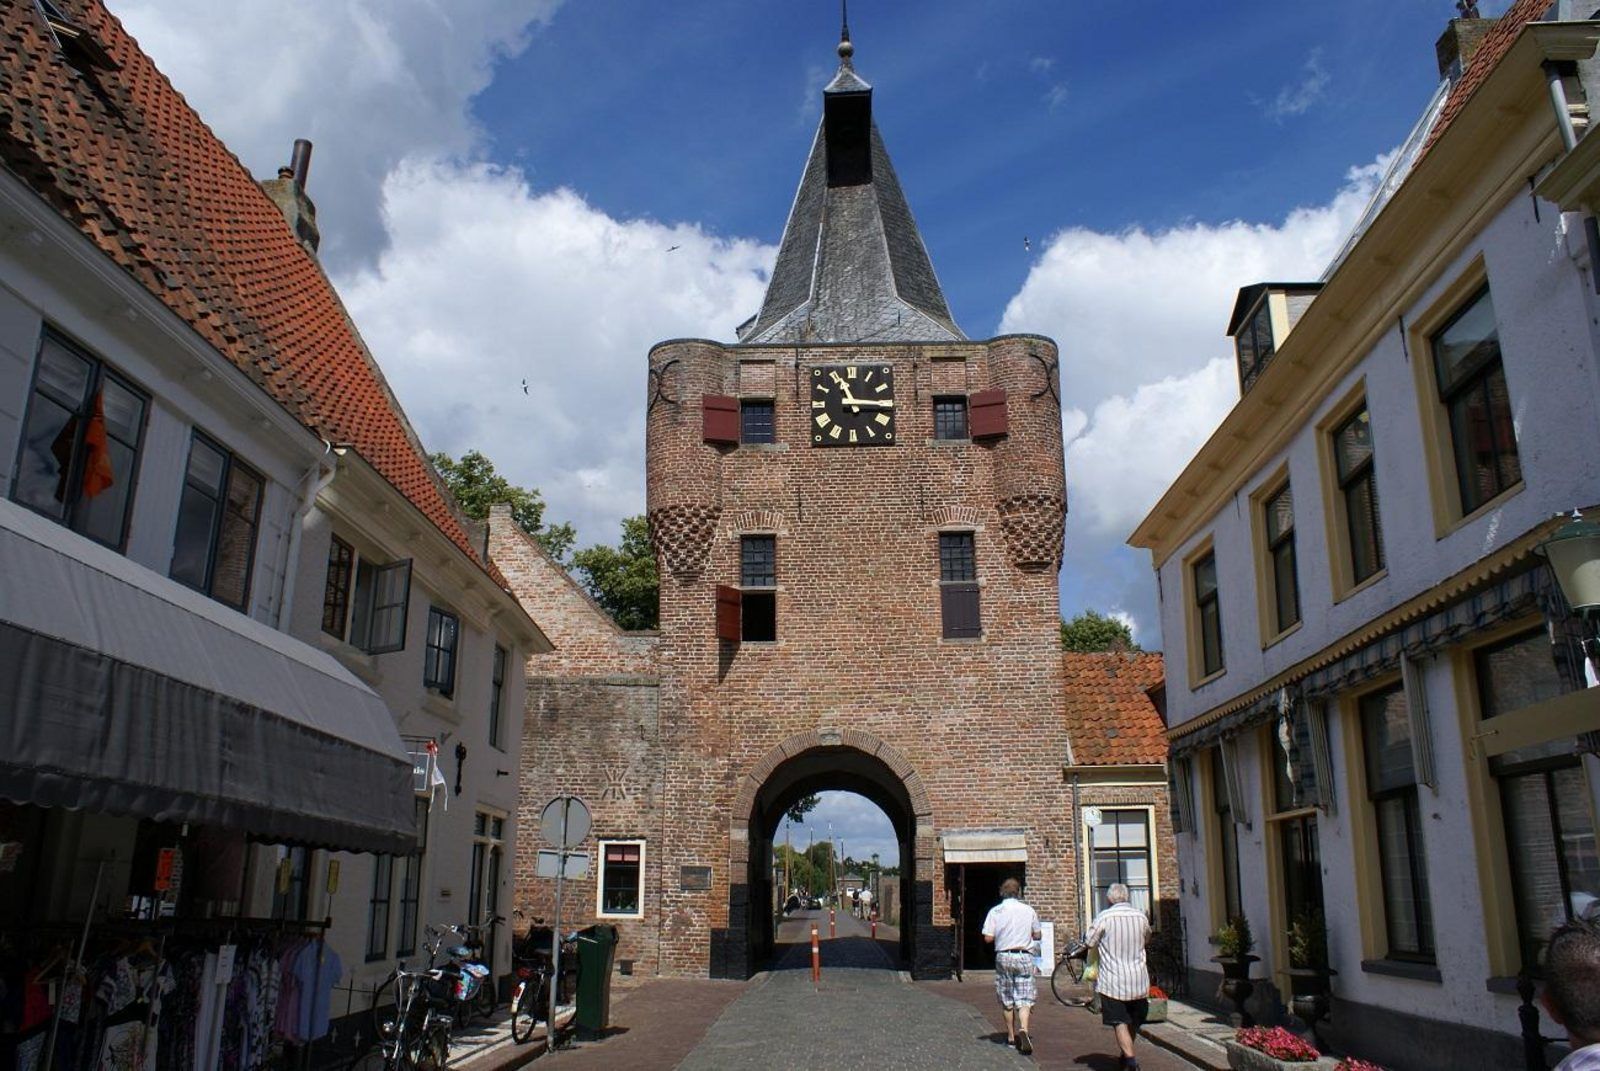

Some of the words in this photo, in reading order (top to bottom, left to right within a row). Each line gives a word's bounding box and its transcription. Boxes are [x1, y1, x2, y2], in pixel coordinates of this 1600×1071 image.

[846, 366, 857, 378] XII
[864, 371, 873, 382] I
[816, 384, 830, 394] X
[811, 400, 825, 408] IX
[829, 425, 842, 439] VII
[849, 429, 858, 442] VI
[865, 425, 876, 438] V
